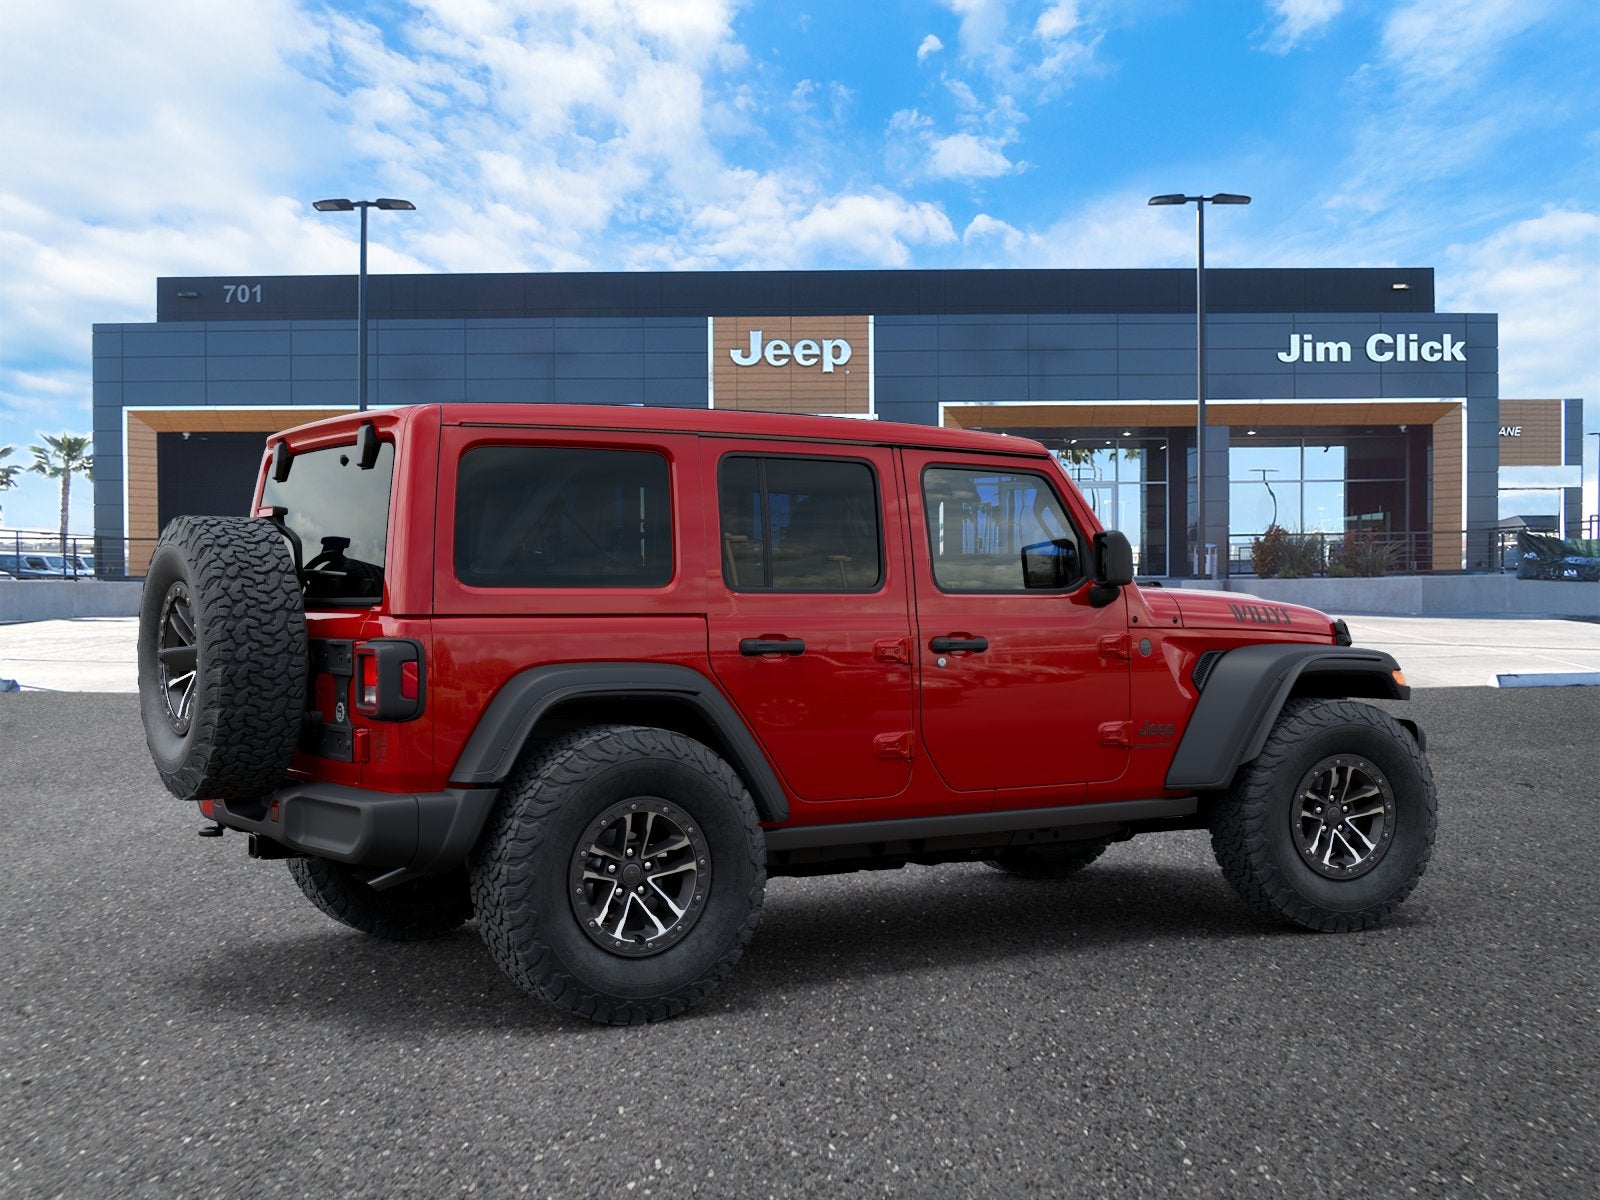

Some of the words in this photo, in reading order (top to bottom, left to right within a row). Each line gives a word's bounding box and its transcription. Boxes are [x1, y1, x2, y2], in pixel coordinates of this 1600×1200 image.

[223, 284, 262, 303] 701
[730, 330, 852, 373] Jeep
[1277, 333, 1351, 362] Jim
[1365, 333, 1467, 362] Click
[1228, 604, 1292, 624] WILLYS
[1138, 719, 1175, 740] Jeep
